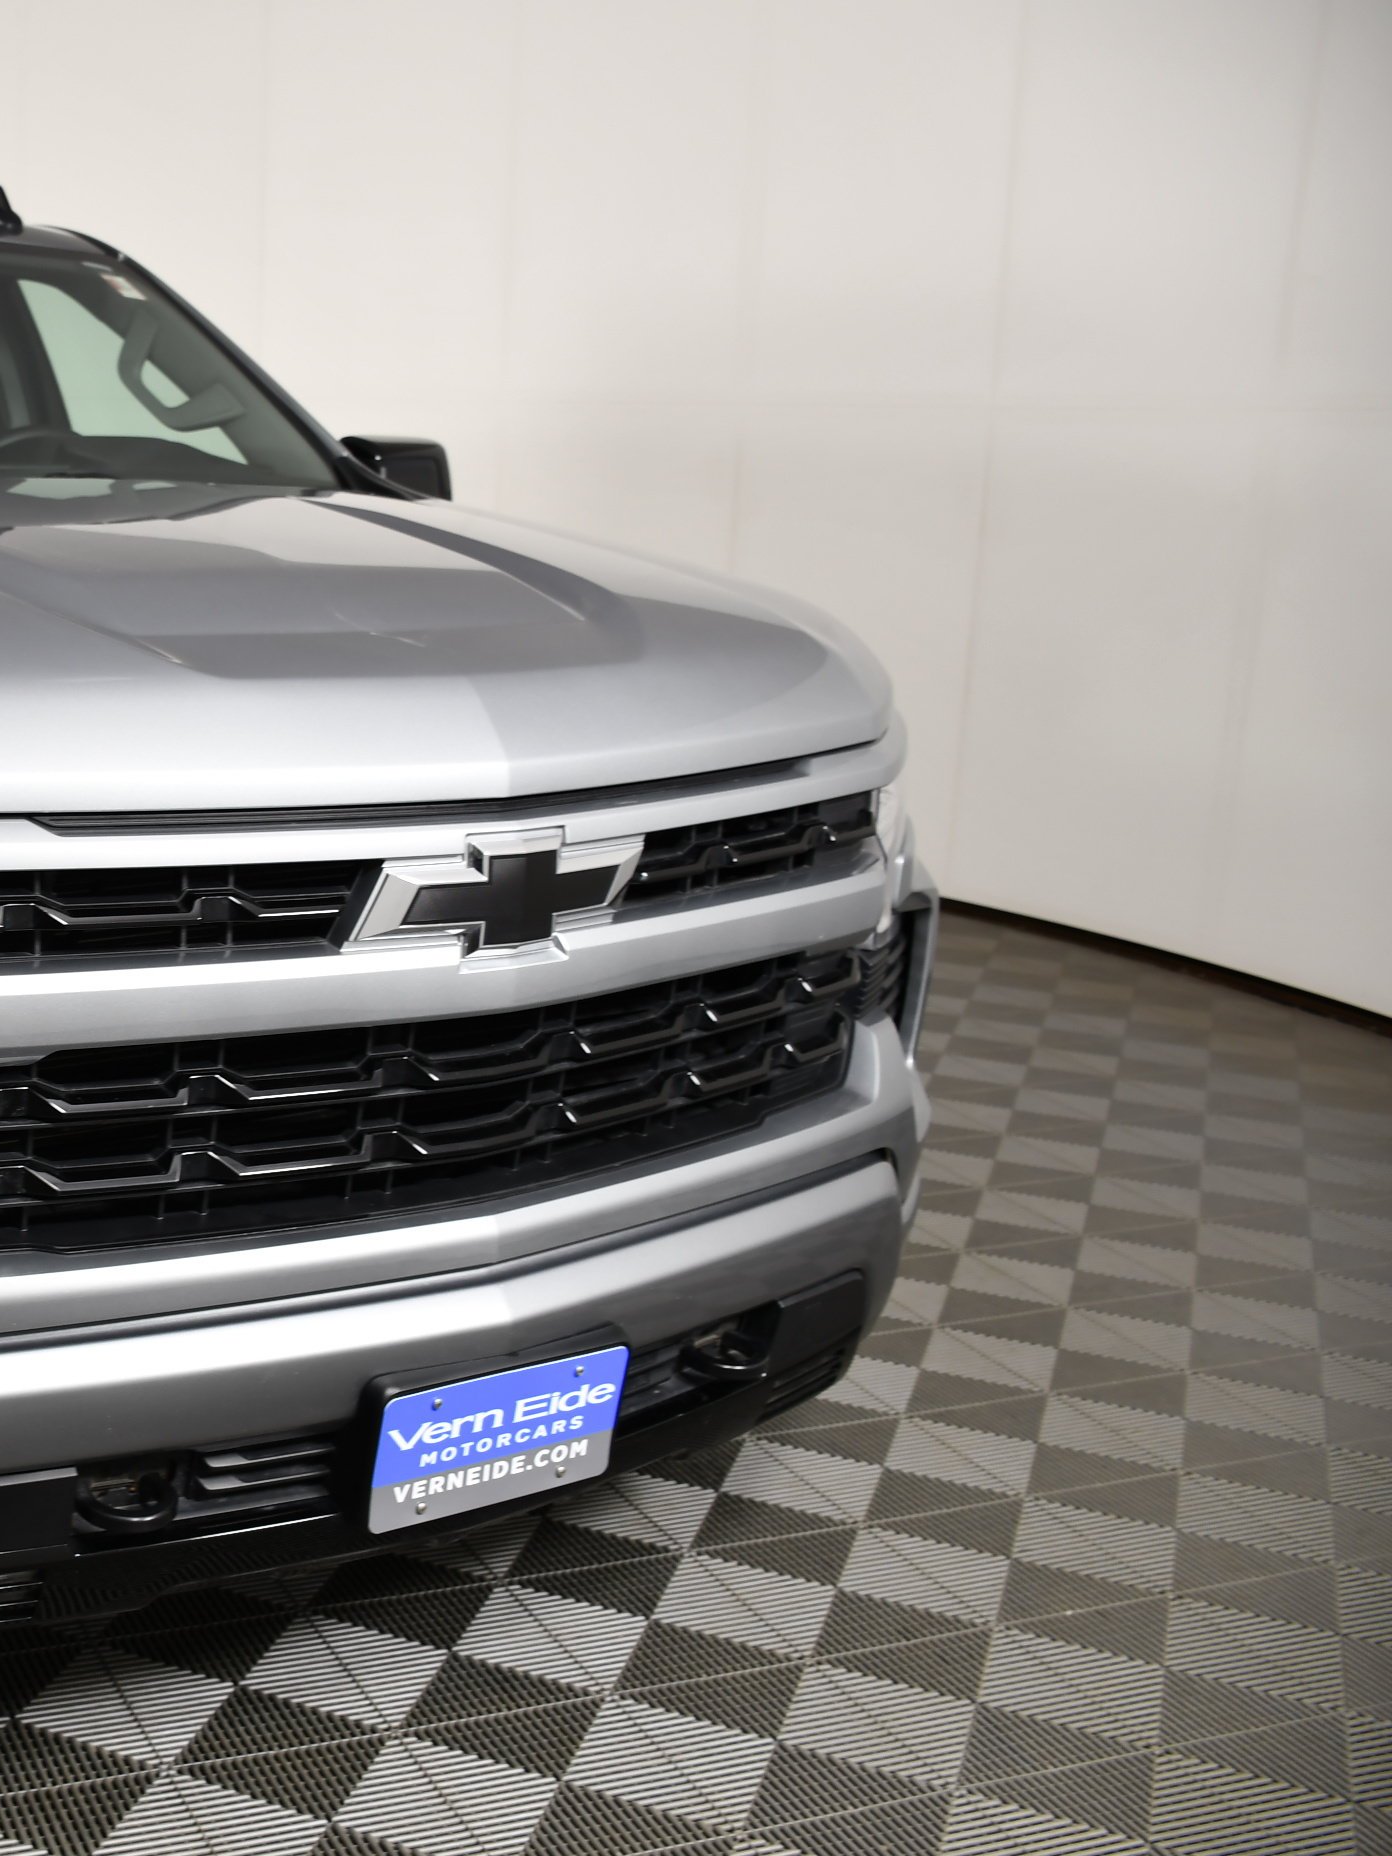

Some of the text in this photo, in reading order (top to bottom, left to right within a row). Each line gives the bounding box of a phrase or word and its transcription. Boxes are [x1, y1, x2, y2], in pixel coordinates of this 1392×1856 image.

[387, 1382, 617, 1451] Vern Eide
[419, 1415, 585, 1467] MOTORCARS
[392, 1439, 590, 1503] VERNEIDE.COM
